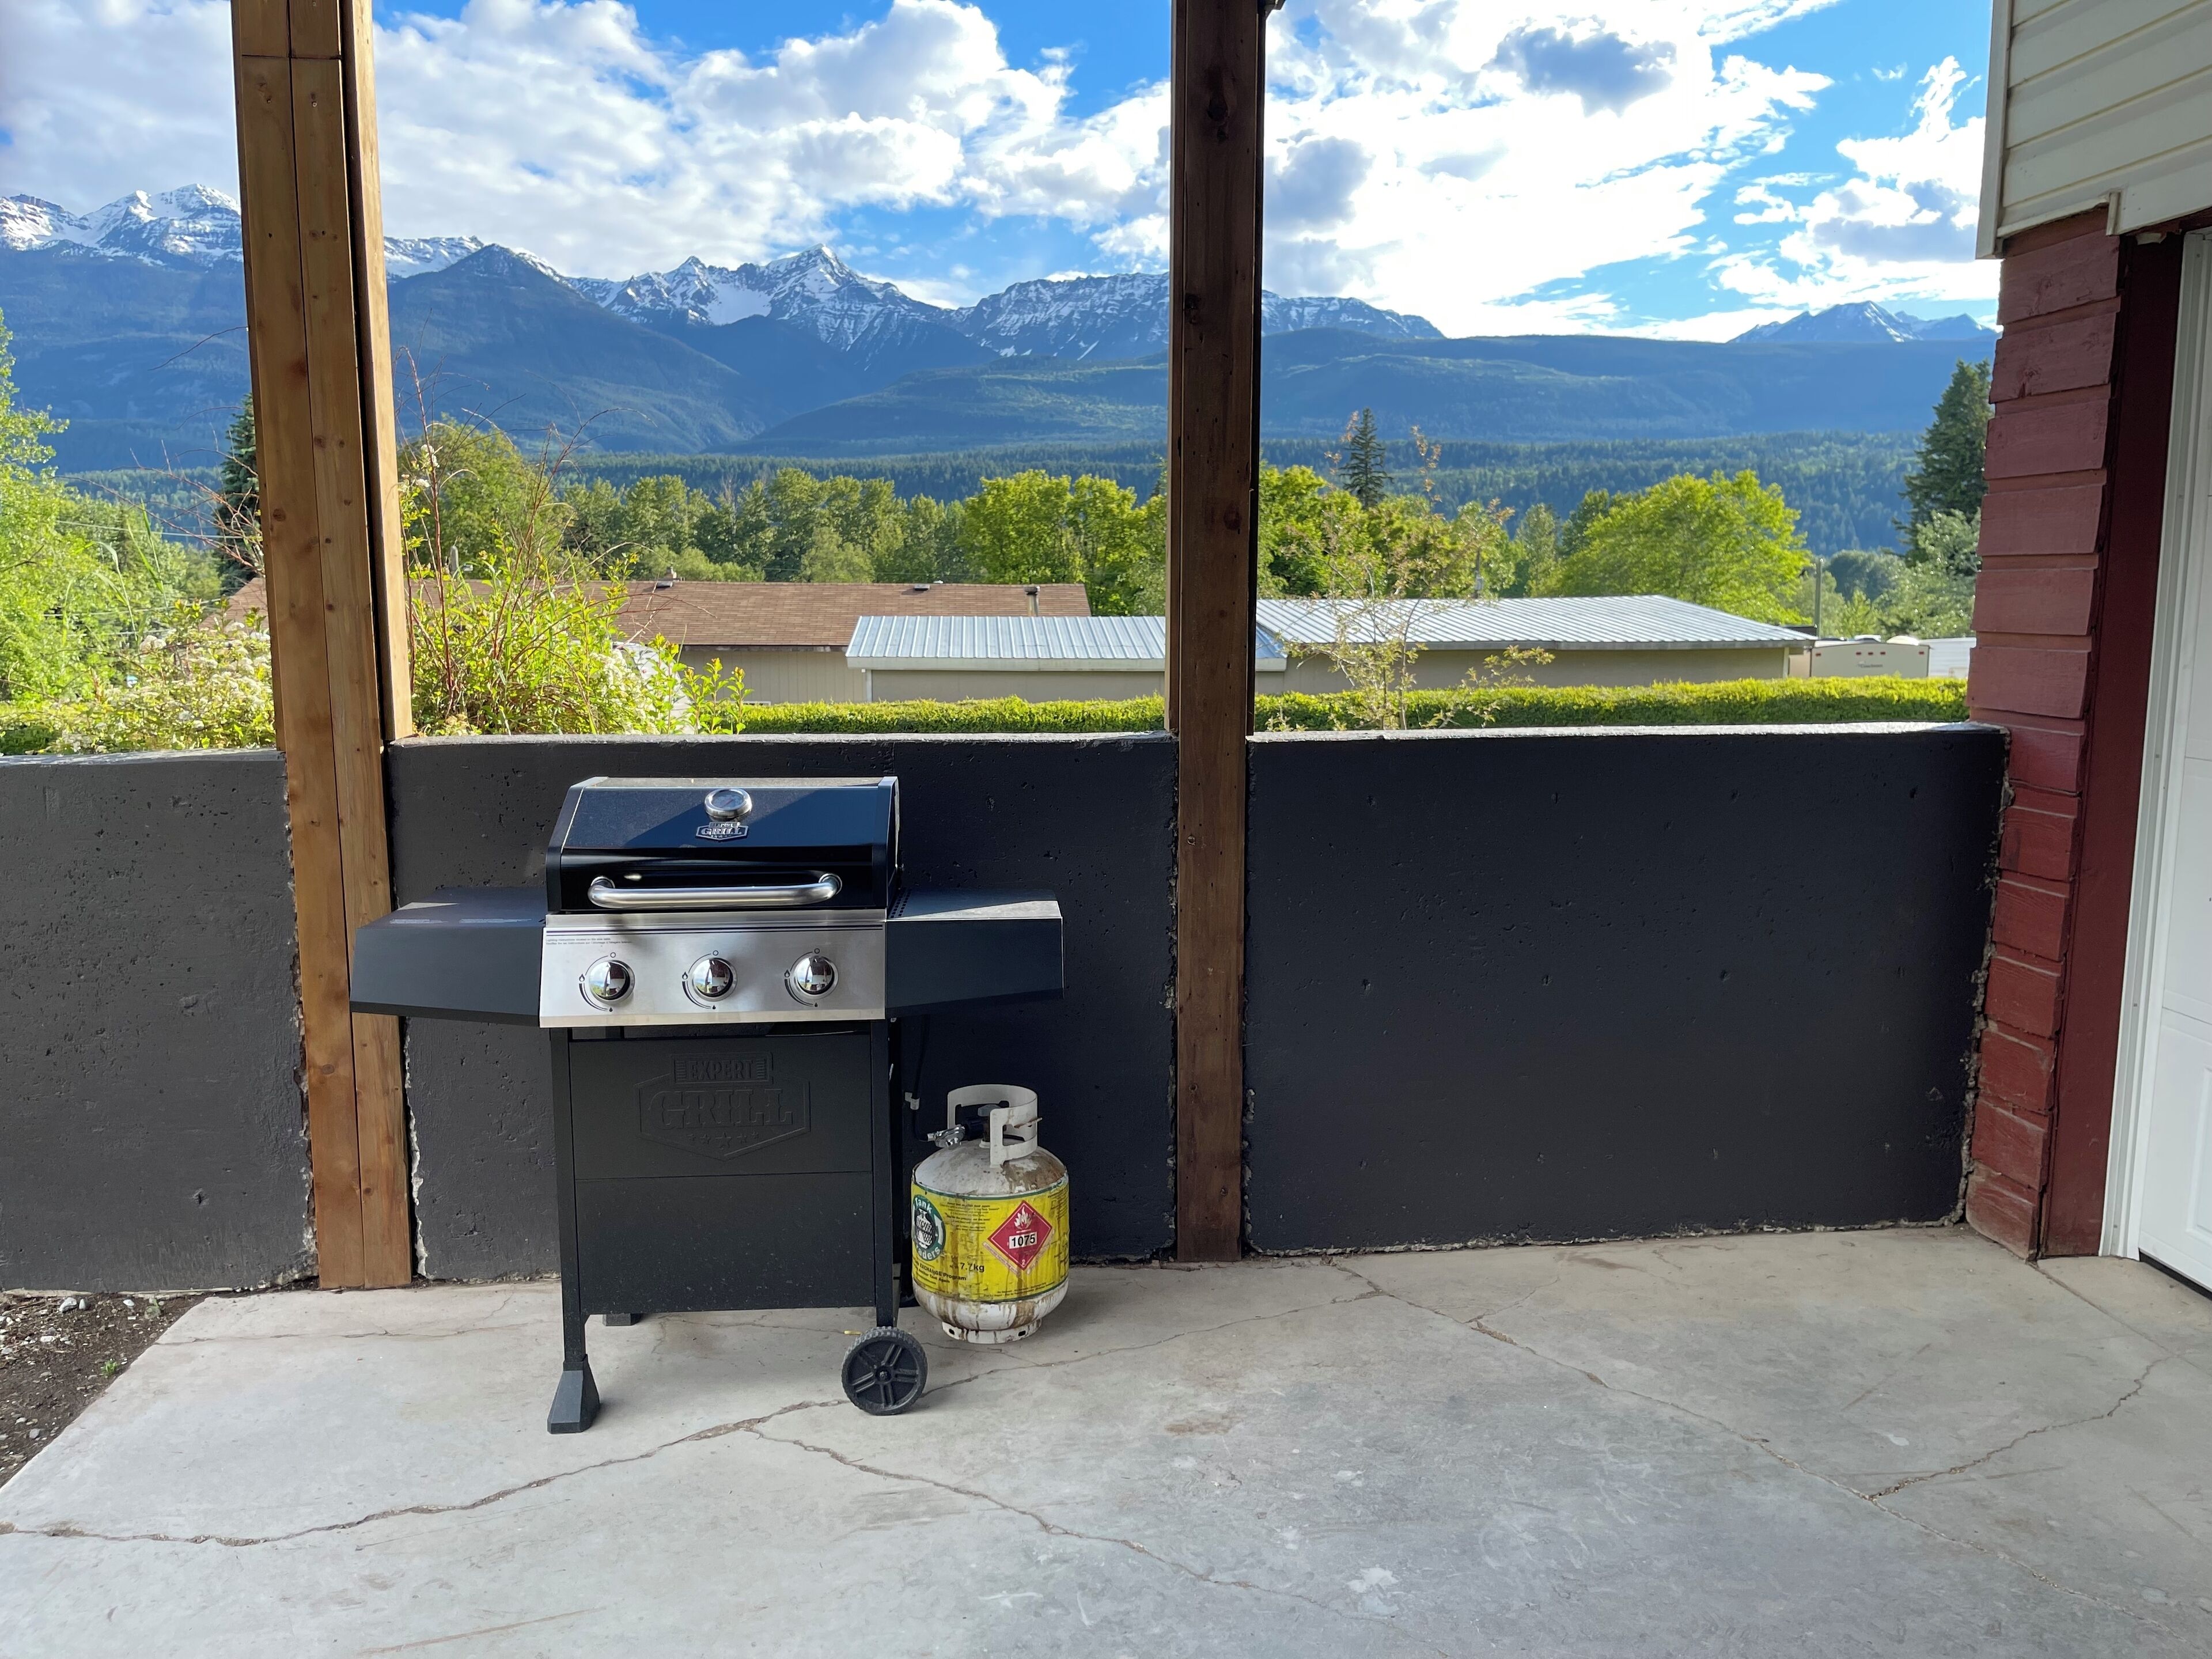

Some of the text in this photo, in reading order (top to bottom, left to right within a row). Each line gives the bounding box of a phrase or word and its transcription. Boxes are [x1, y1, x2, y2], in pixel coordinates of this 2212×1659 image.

[700, 827, 743, 835] GRILL
[688, 1060, 753, 1081] EXPERT
[648, 1089, 793, 1130] GRILL
[915, 1197, 933, 1214] Tank
[1012, 1233, 1036, 1247] 1075
[916, 1245, 941, 1260] aders
[942, 1272, 967, 1281] Program
